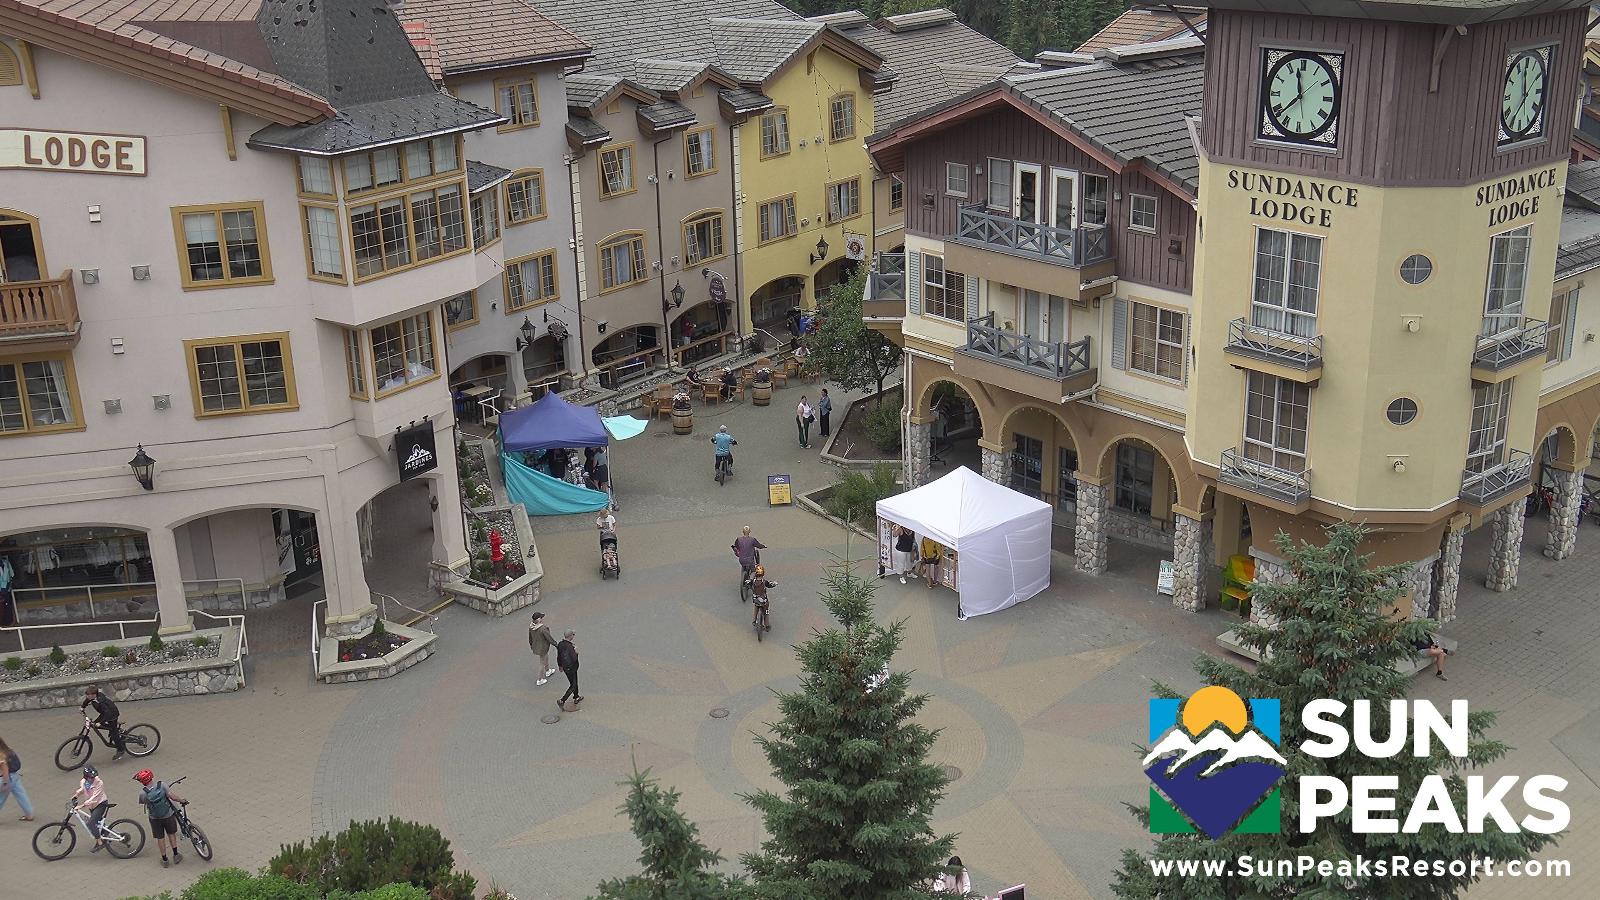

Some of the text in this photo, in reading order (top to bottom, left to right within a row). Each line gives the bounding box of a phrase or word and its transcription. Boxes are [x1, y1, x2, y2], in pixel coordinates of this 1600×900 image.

[24, 134, 134, 171] LODGE
[1227, 169, 1359, 208] SUNDANCE
[1475, 167, 1557, 207] SUNDANCE
[1249, 197, 1332, 228] LODGE
[1488, 195, 1540, 228] LODGE
